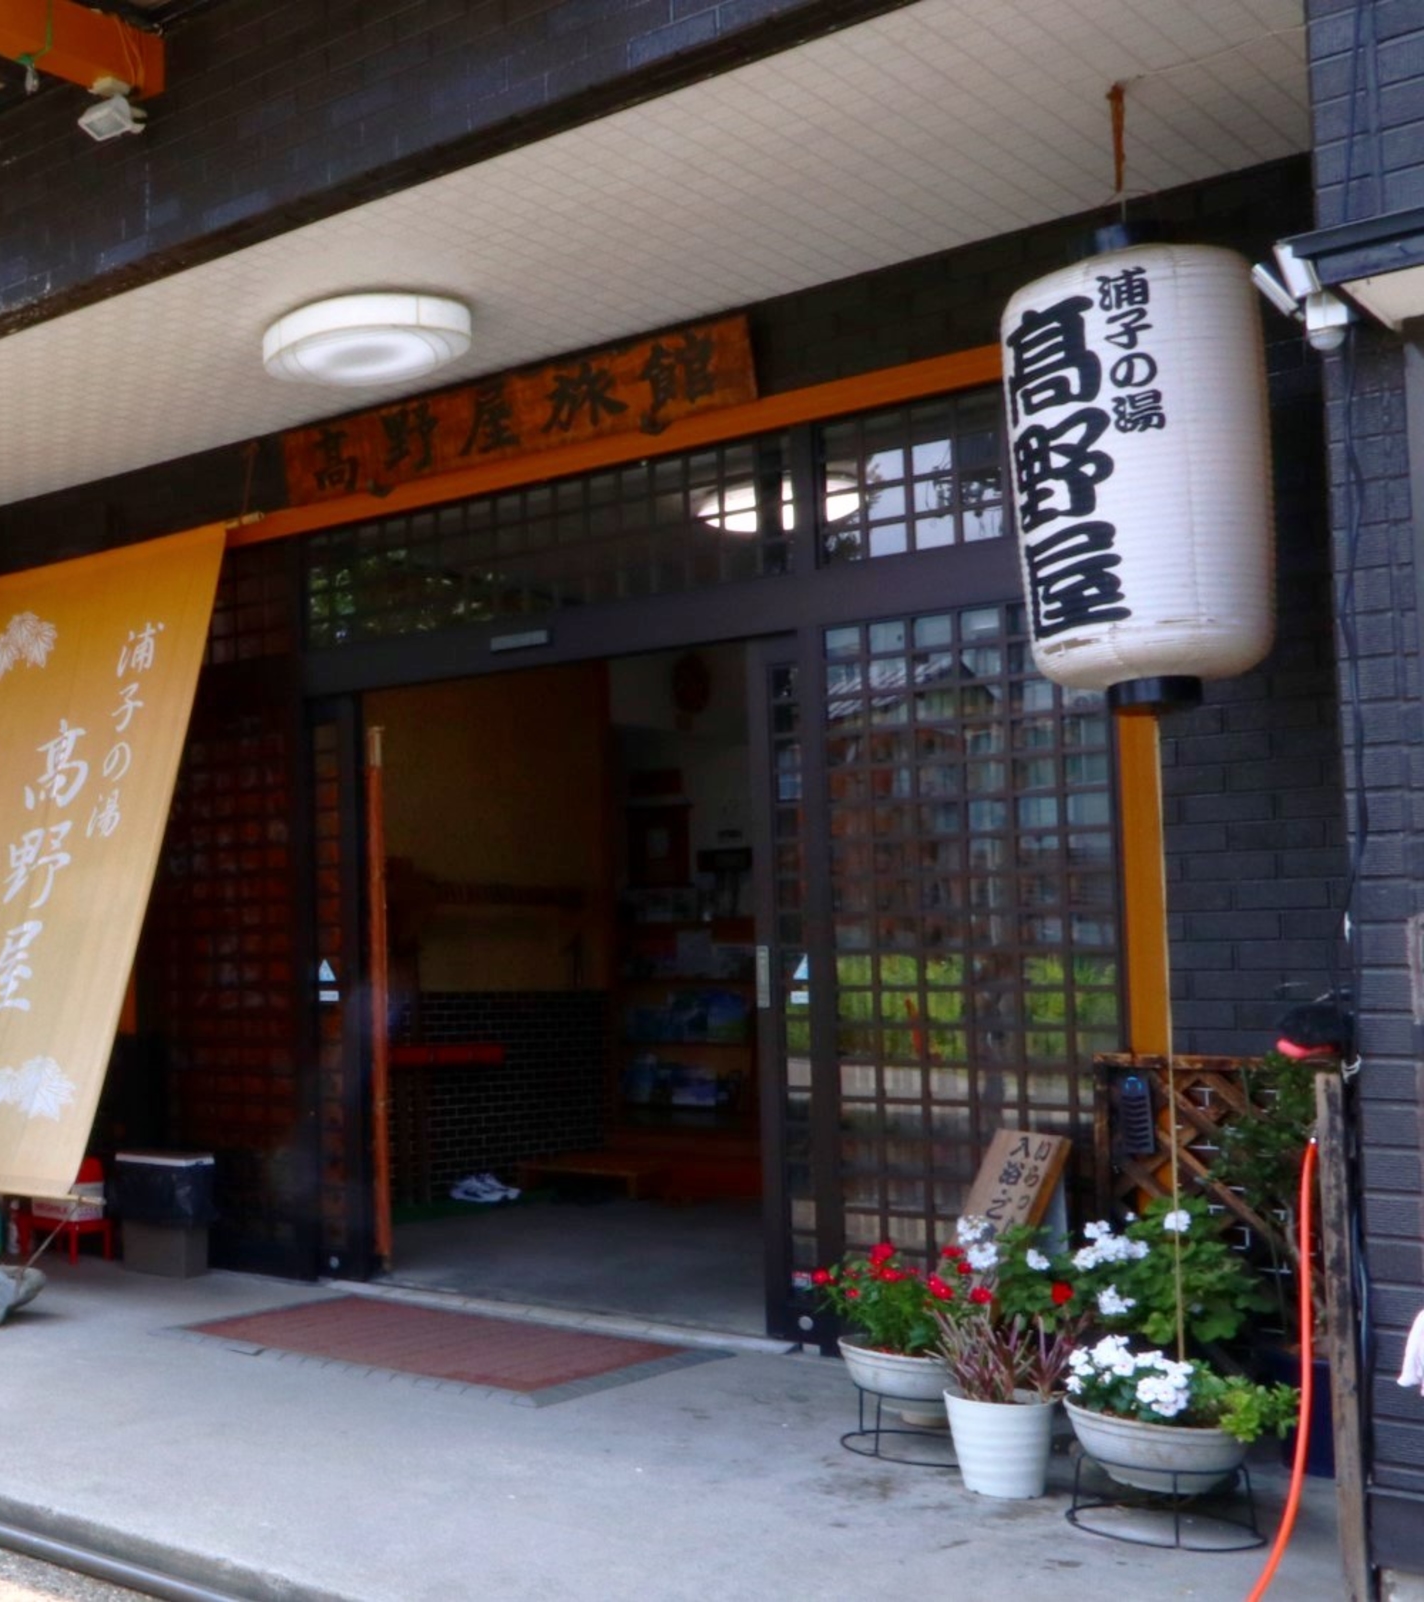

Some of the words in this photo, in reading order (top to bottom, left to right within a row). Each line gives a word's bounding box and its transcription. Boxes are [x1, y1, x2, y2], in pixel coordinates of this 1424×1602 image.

[1096, 266, 1166, 433] 浦子の湯
[86, 622, 165, 838] 浦子の湯
